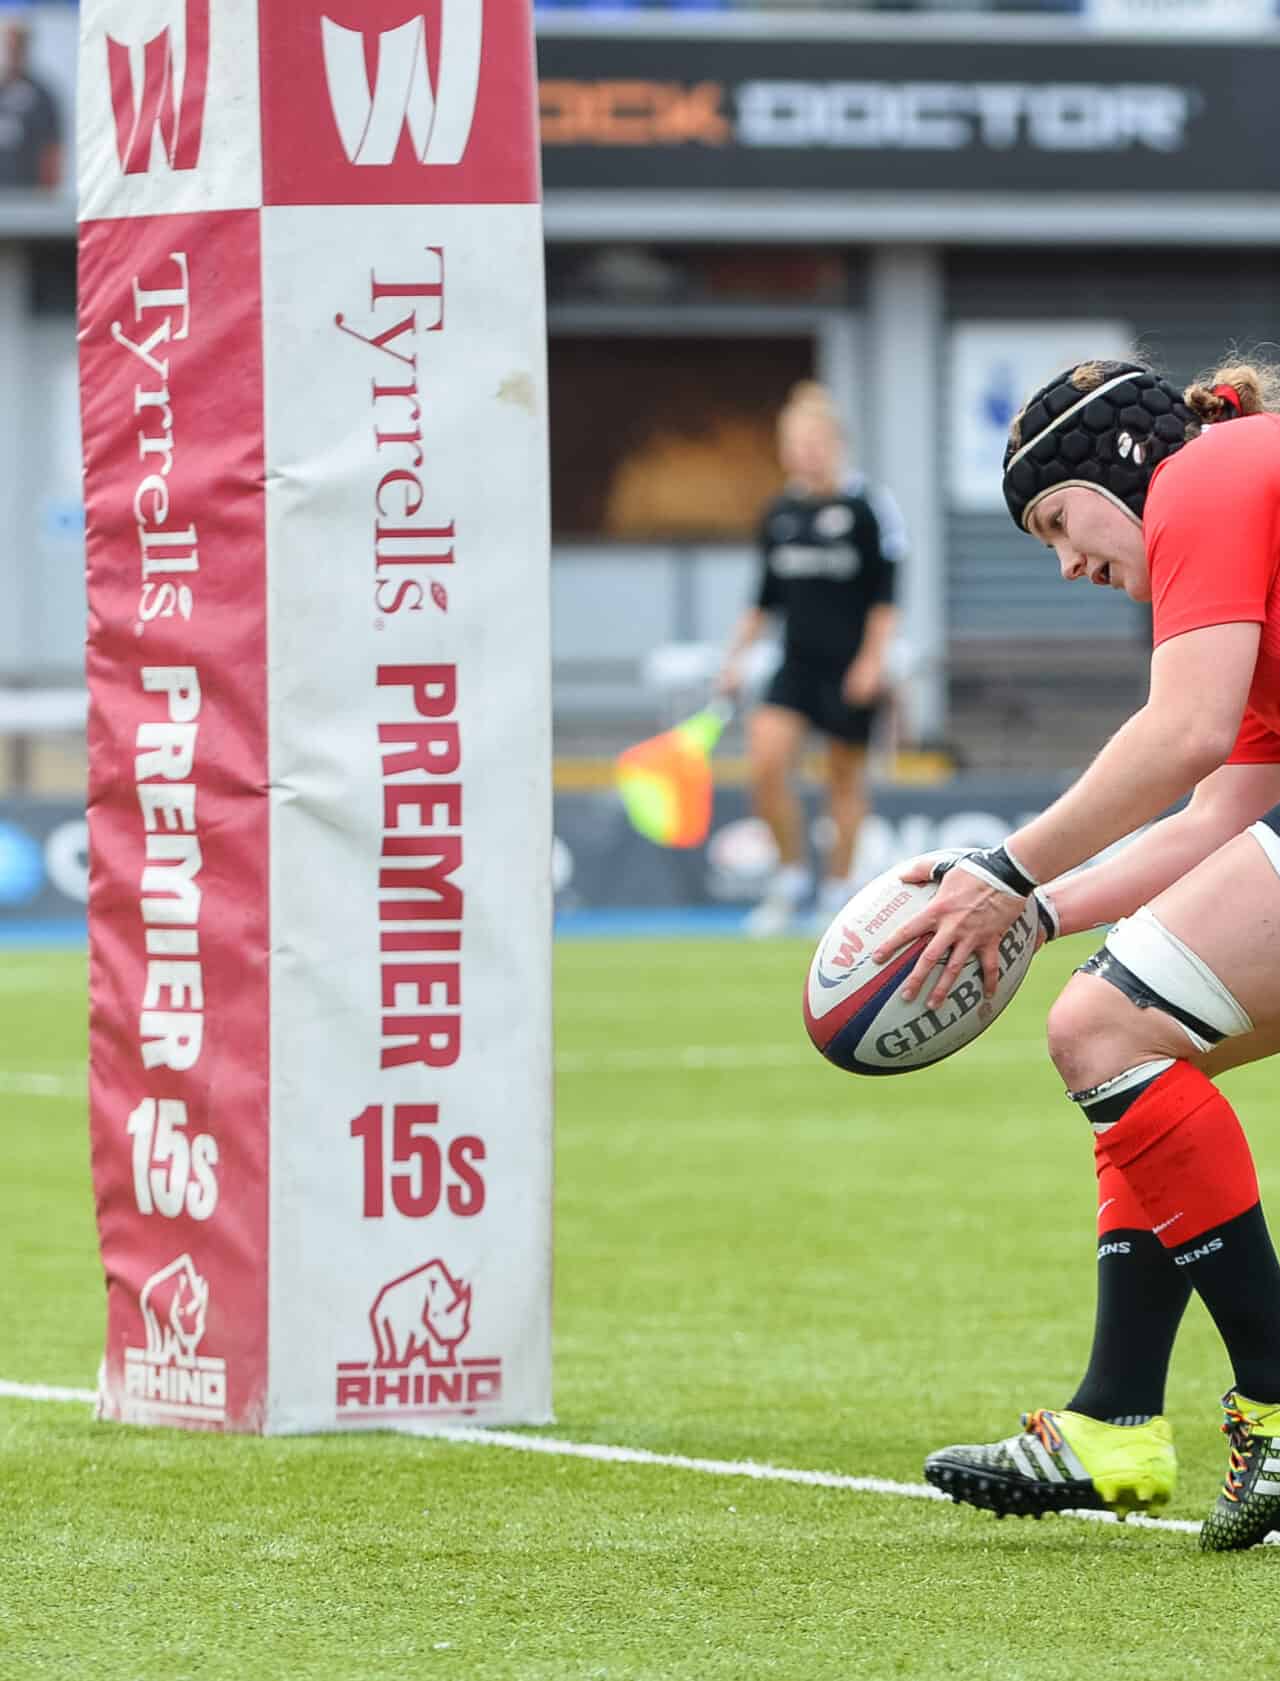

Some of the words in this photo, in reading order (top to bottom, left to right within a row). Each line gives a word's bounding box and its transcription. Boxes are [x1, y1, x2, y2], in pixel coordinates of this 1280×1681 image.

[736, 79, 1190, 153] DOCTOR
[136, 666, 205, 1072] PREMIER
[375, 664, 464, 1071] PREMIER
[876, 914, 1034, 1059] GILBRT
[126, 1098, 220, 1222] 15s
[350, 1103, 486, 1219] 15s
[124, 1367, 227, 1411] RHINO
[337, 1371, 502, 1407] RHINO
